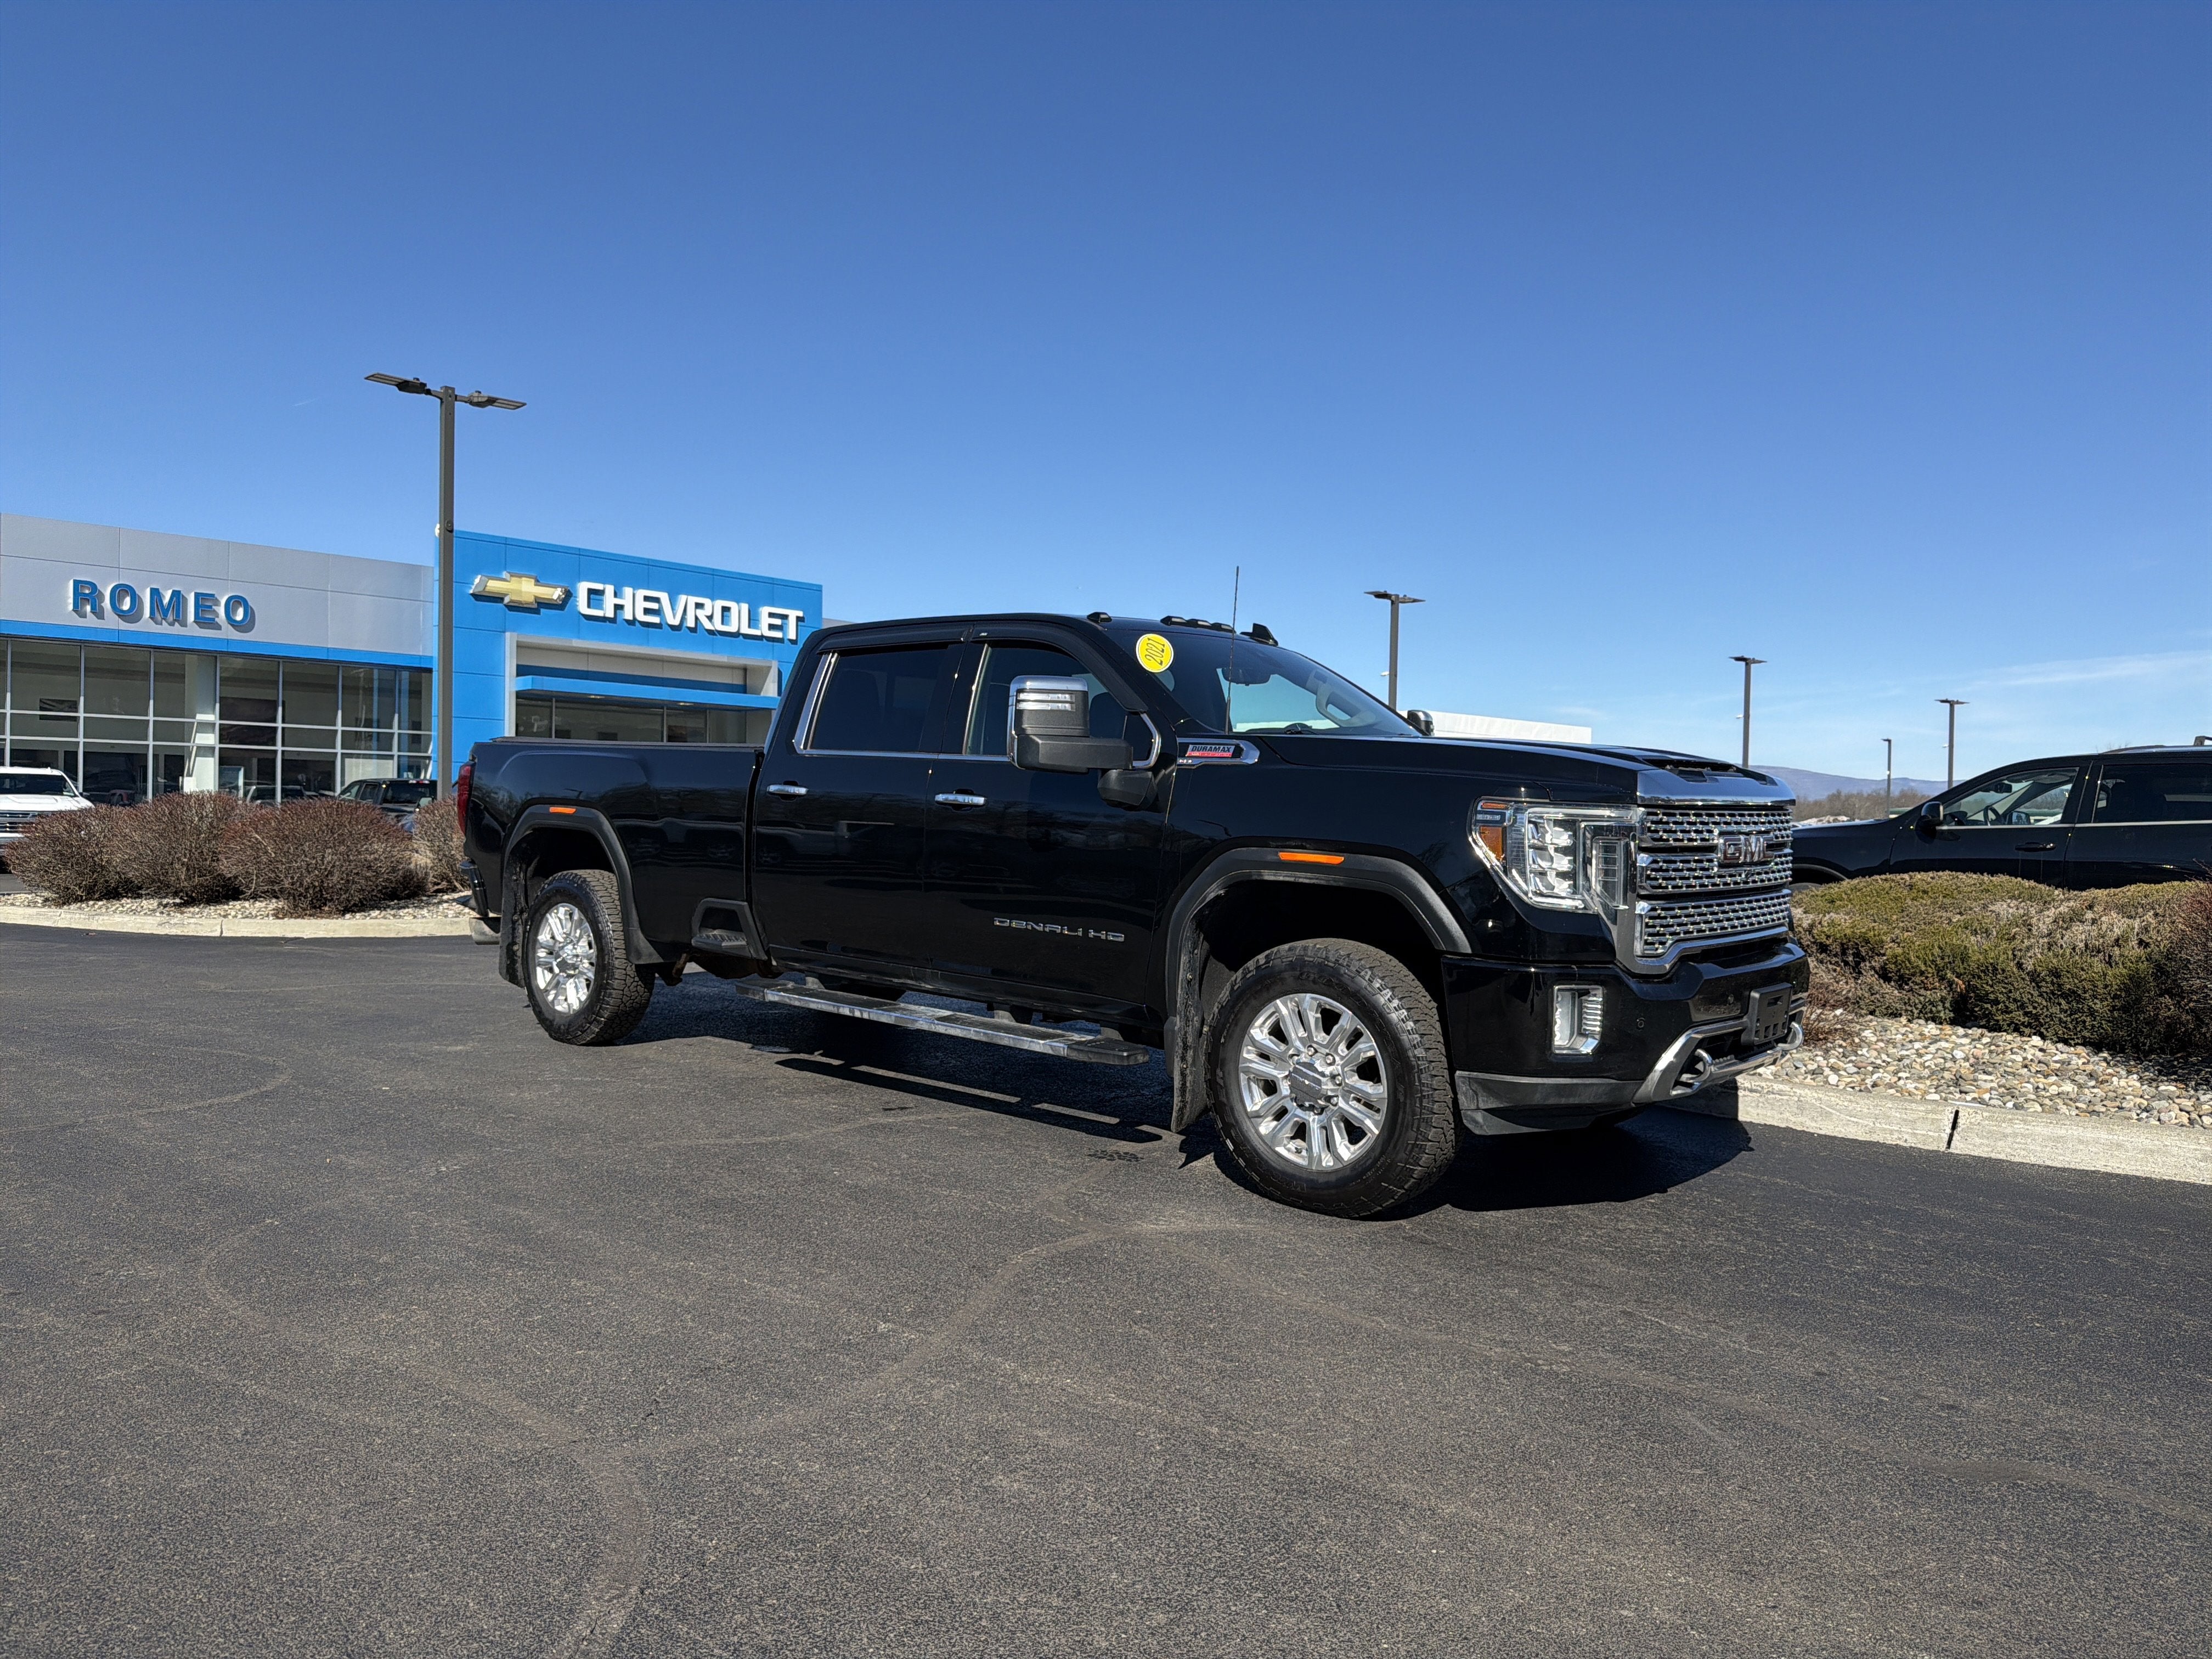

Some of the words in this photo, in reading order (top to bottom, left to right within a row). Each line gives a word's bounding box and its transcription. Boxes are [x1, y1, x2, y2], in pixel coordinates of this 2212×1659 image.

[71, 579, 251, 625] ROMEO
[578, 581, 804, 640] CHEVROLET
[1145, 637, 1165, 666] 2021
[1718, 834, 1775, 862] GMC
[994, 917, 1082, 937] DENALI
[1088, 929, 1125, 942] HD
